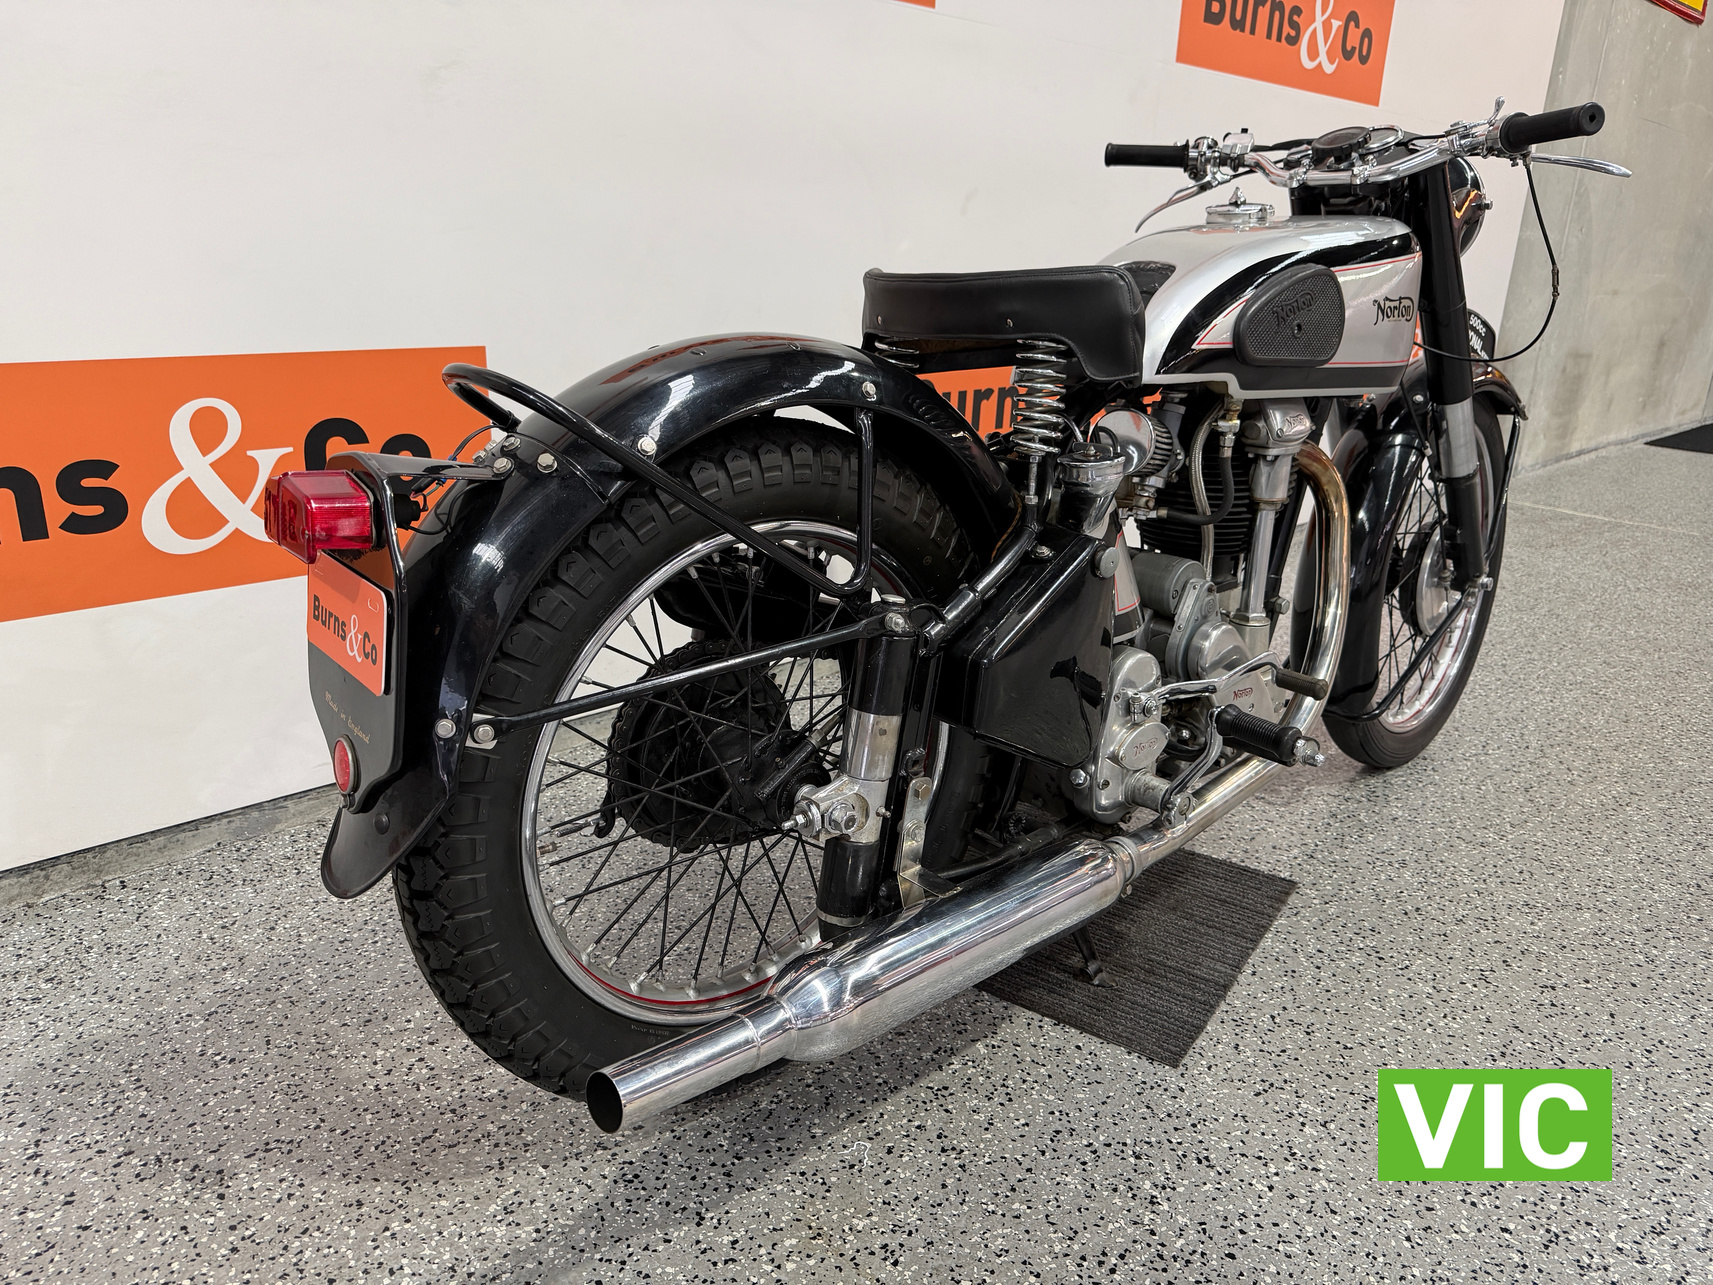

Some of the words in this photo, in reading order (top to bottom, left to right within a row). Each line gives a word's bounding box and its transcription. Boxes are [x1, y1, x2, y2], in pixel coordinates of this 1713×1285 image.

[1272, 290, 1316, 328] Norton
[1373, 296, 1415, 326] Norton
[312, 593, 378, 666] Burns&Co
[1232, 687, 1254, 701] Norton
